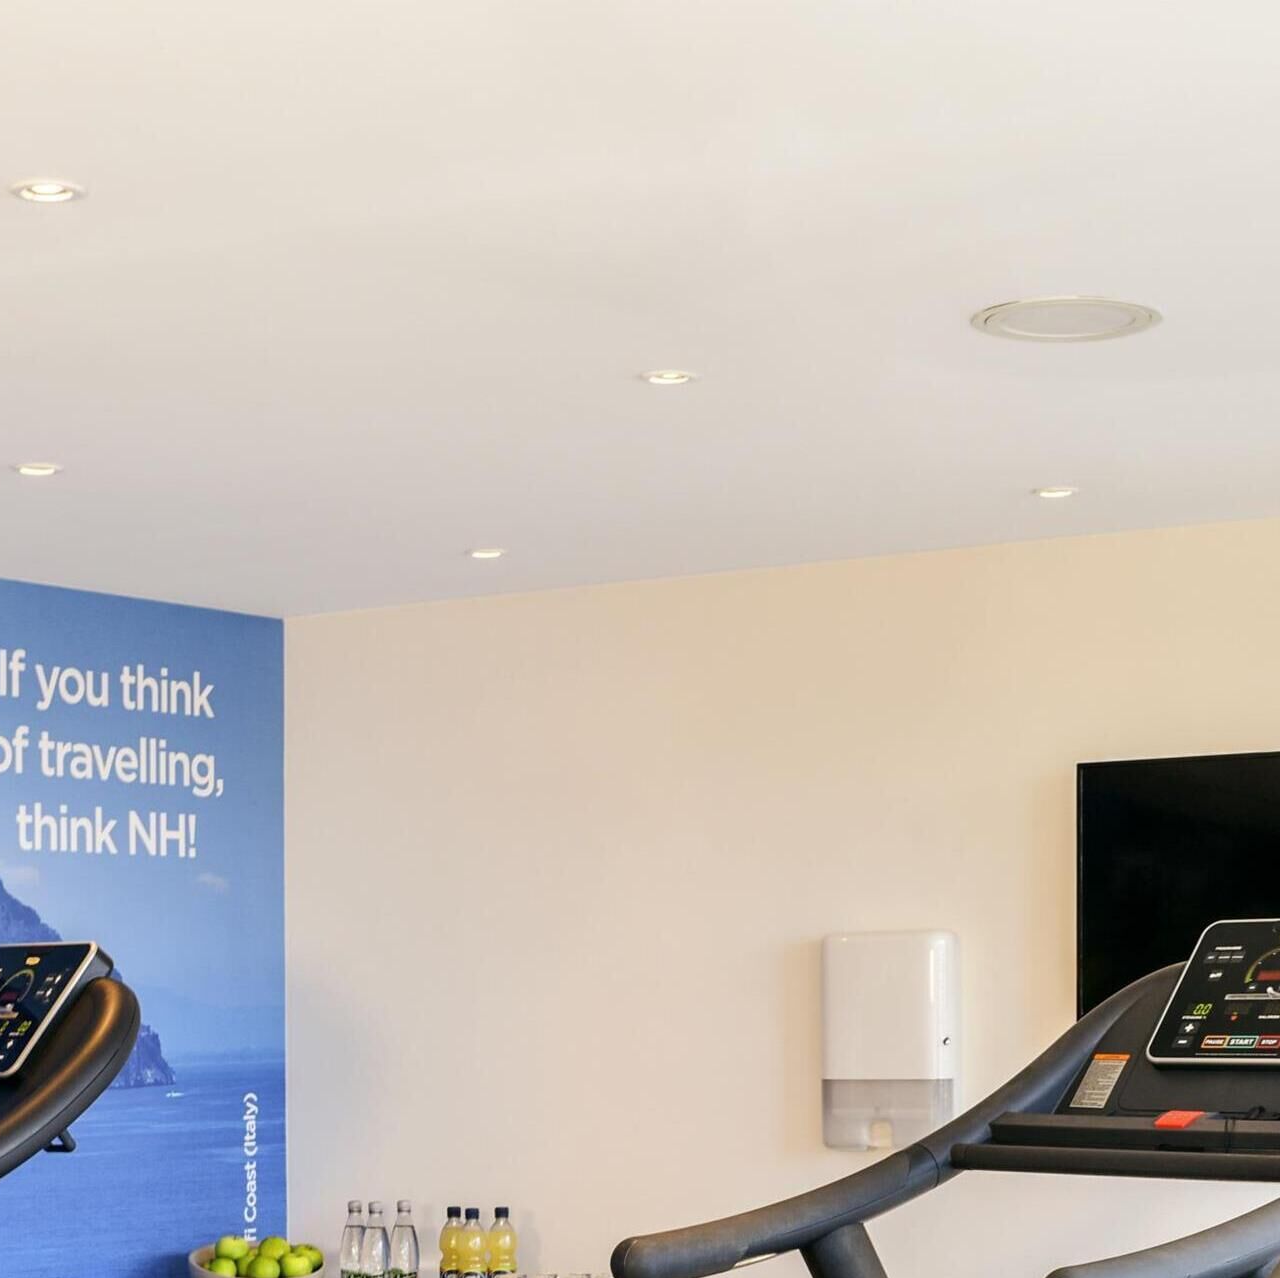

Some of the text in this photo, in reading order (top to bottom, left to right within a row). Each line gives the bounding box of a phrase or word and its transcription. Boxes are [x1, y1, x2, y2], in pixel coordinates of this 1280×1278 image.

[35, 663, 110, 711] you
[120, 664, 215, 719] think
[38, 730, 225, 798] travelling,
[16, 802, 197, 858] think NH!
[243, 1092, 258, 1157] (Italy)
[243, 1160, 257, 1223] Coast
